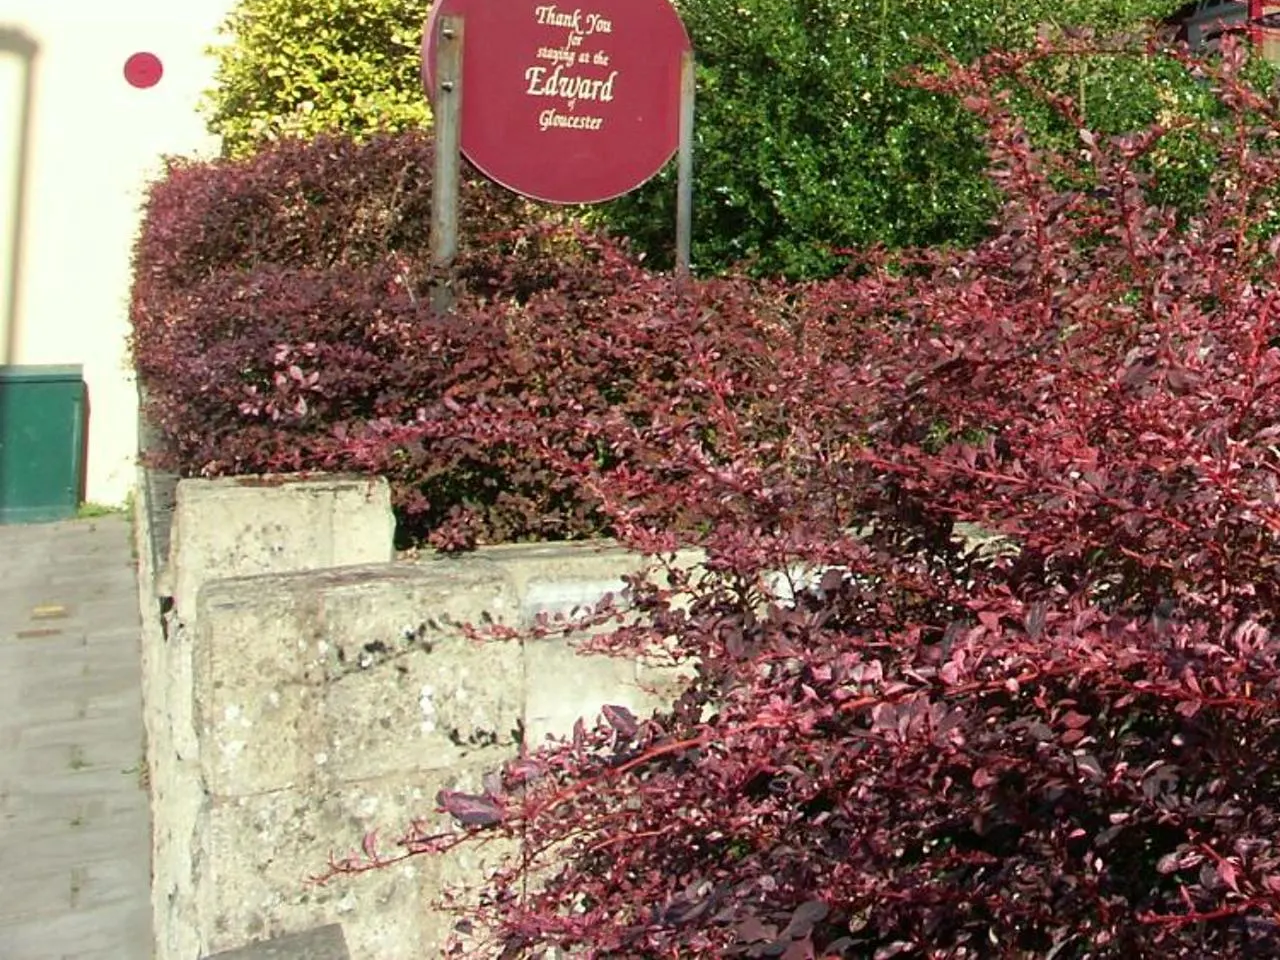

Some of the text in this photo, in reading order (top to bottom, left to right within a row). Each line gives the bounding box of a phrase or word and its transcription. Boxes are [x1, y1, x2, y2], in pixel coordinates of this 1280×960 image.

[535, 5, 612, 35] Thank You
[566, 30, 584, 51] for
[536, 46, 609, 68] staying at the
[525, 63, 619, 102] Edward
[539, 107, 603, 132] Gloucester
